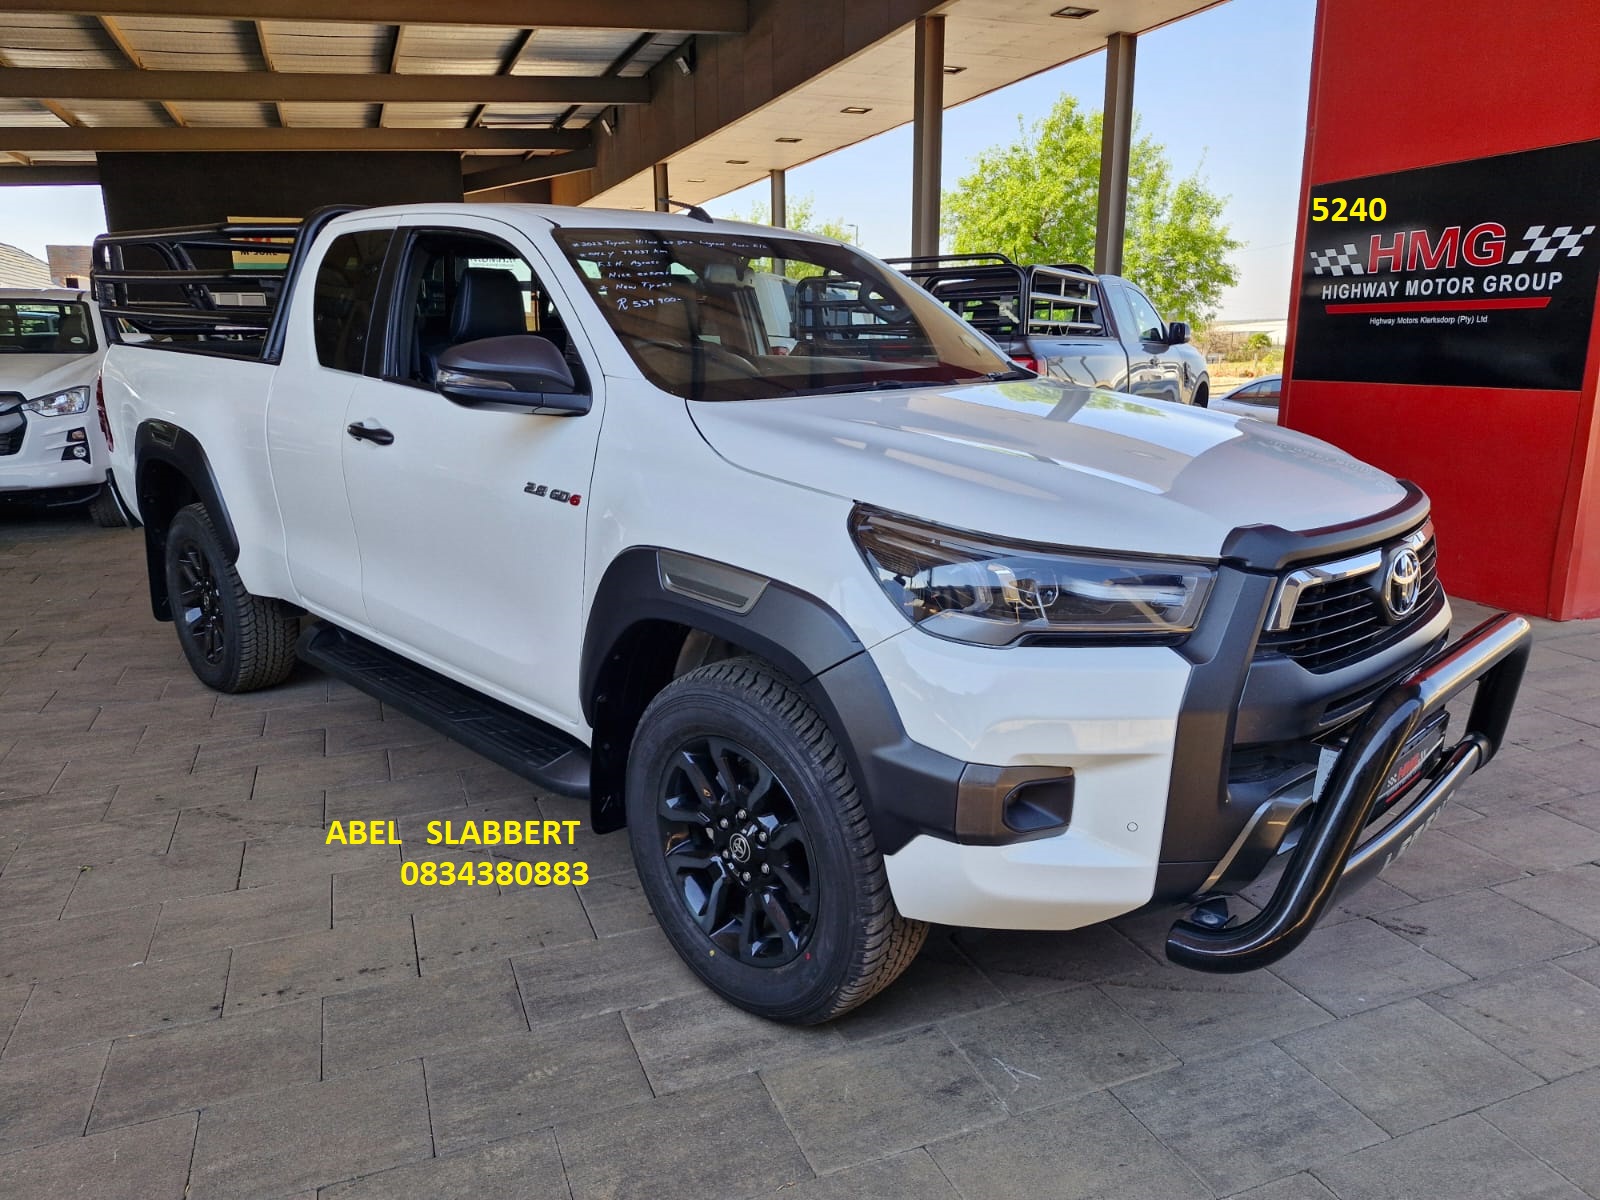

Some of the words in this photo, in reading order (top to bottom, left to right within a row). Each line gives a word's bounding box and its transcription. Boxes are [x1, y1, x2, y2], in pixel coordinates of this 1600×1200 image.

[1367, 222, 1506, 274] HMG
[1322, 281, 1399, 300] HIGHWAY
[1405, 276, 1474, 297] MOTOR
[1483, 272, 1564, 293] GROUP
[1369, 317, 1396, 327] Highway
[1396, 316, 1419, 325] Motors
[1457, 315, 1475, 325] (Pty)
[1476, 314, 1489, 323] Ltd
